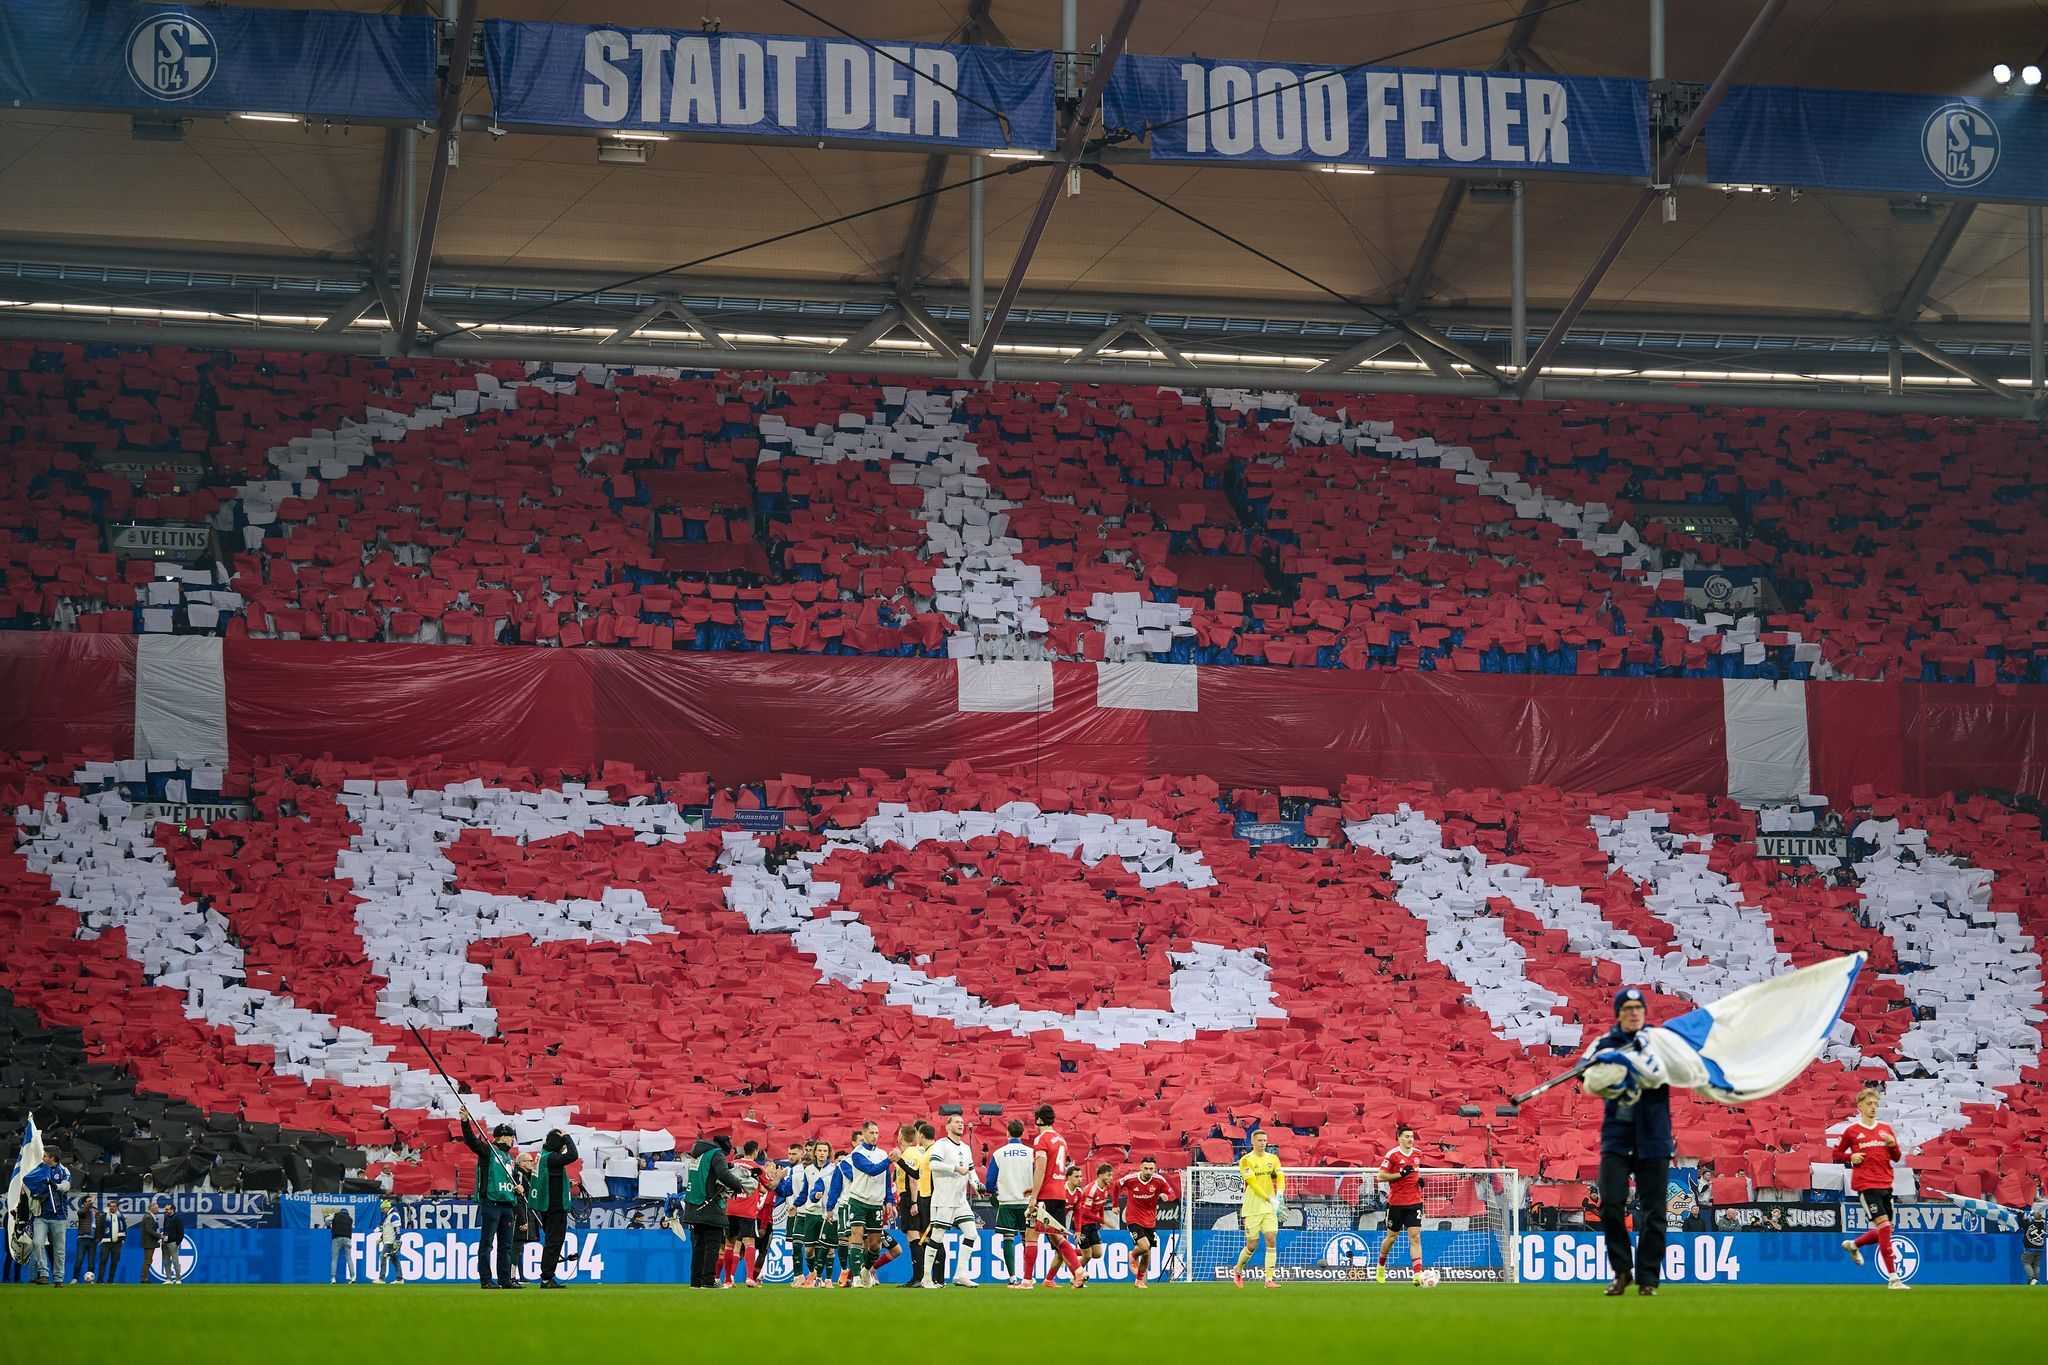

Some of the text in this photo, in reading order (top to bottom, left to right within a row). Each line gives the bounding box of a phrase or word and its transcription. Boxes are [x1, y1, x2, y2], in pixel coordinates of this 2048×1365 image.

[157, 63, 182, 90] 04
[584, 30, 959, 138] STADT DER
[1181, 64, 1570, 164] 1000 FEUER
[1948, 151, 1970, 178] 04
[140, 530, 206, 547] VELTINS
[1763, 838, 1838, 856] VELTINS
[1003, 1149, 1027, 1158] HRS
[103, 1193, 213, 1214] FanClub
[222, 1193, 264, 1214] UK
[284, 1193, 347, 1205] Königsblau
[1785, 1208, 1836, 1228] JUNGS
[1856, 1207, 1962, 1230] KRVE
[555, 1232, 605, 1280] 04
[1694, 1235, 1741, 1281] 04
[768, 1260, 783, 1275] 04
[1215, 1266, 1366, 1280] Eisenbch Tresore.de
